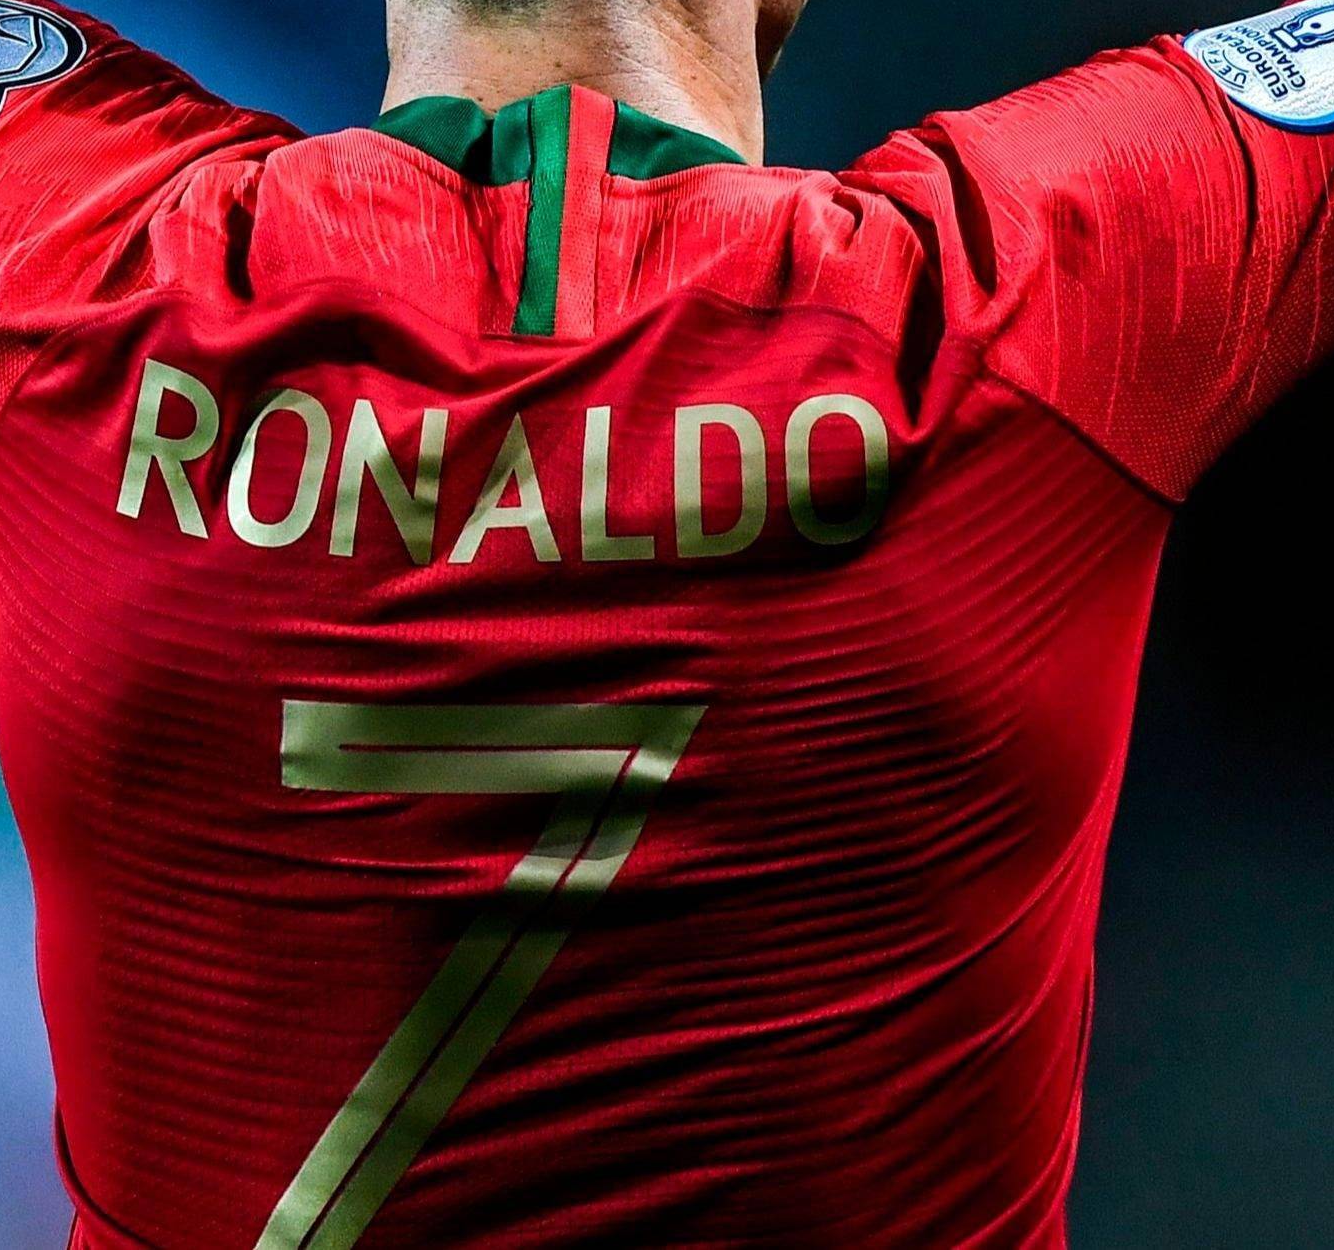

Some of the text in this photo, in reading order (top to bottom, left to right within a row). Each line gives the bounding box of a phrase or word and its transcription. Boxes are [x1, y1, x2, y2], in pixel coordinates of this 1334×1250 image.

[1208, 49, 1247, 84] UEFA
[1215, 32, 1288, 98] EUROPEAN
[1235, 25, 1306, 88] CHAMPIONS
[116, 358, 890, 565] RONALDO
[253, 699, 708, 1250] 7
